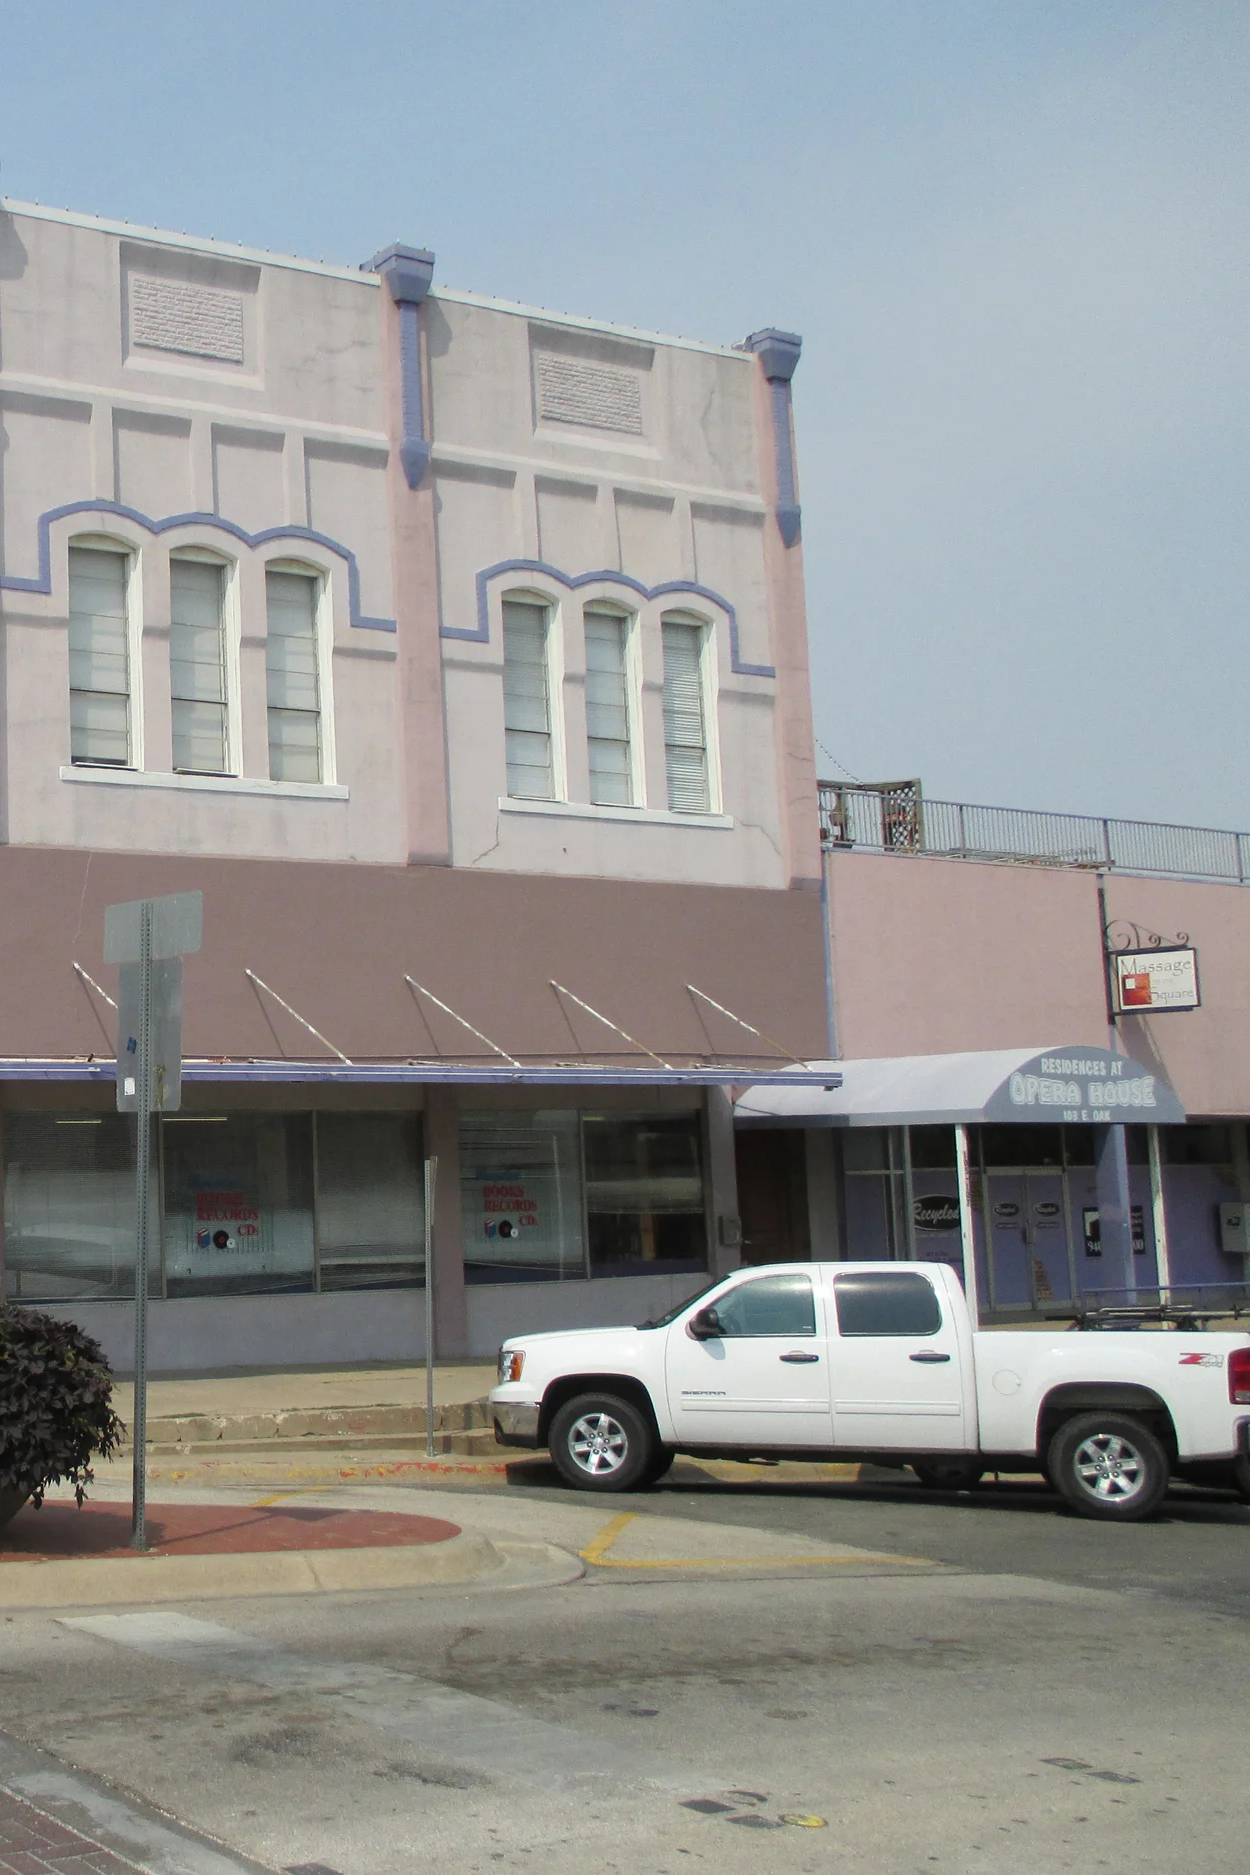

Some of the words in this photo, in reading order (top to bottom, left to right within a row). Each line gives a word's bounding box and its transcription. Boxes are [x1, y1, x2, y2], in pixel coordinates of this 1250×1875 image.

[1121, 958, 1191, 977] Massage
[1041, 1058, 1106, 1076] RESIDENCES
[1110, 1060, 1122, 1076] AT
[1010, 1072, 1082, 1105] OPERA
[1088, 1076, 1156, 1106] HOUSE
[197, 1207, 259, 1221] RECORDS
[484, 1200, 537, 1212] RECORDS
[913, 1203, 959, 1224] Recycled
